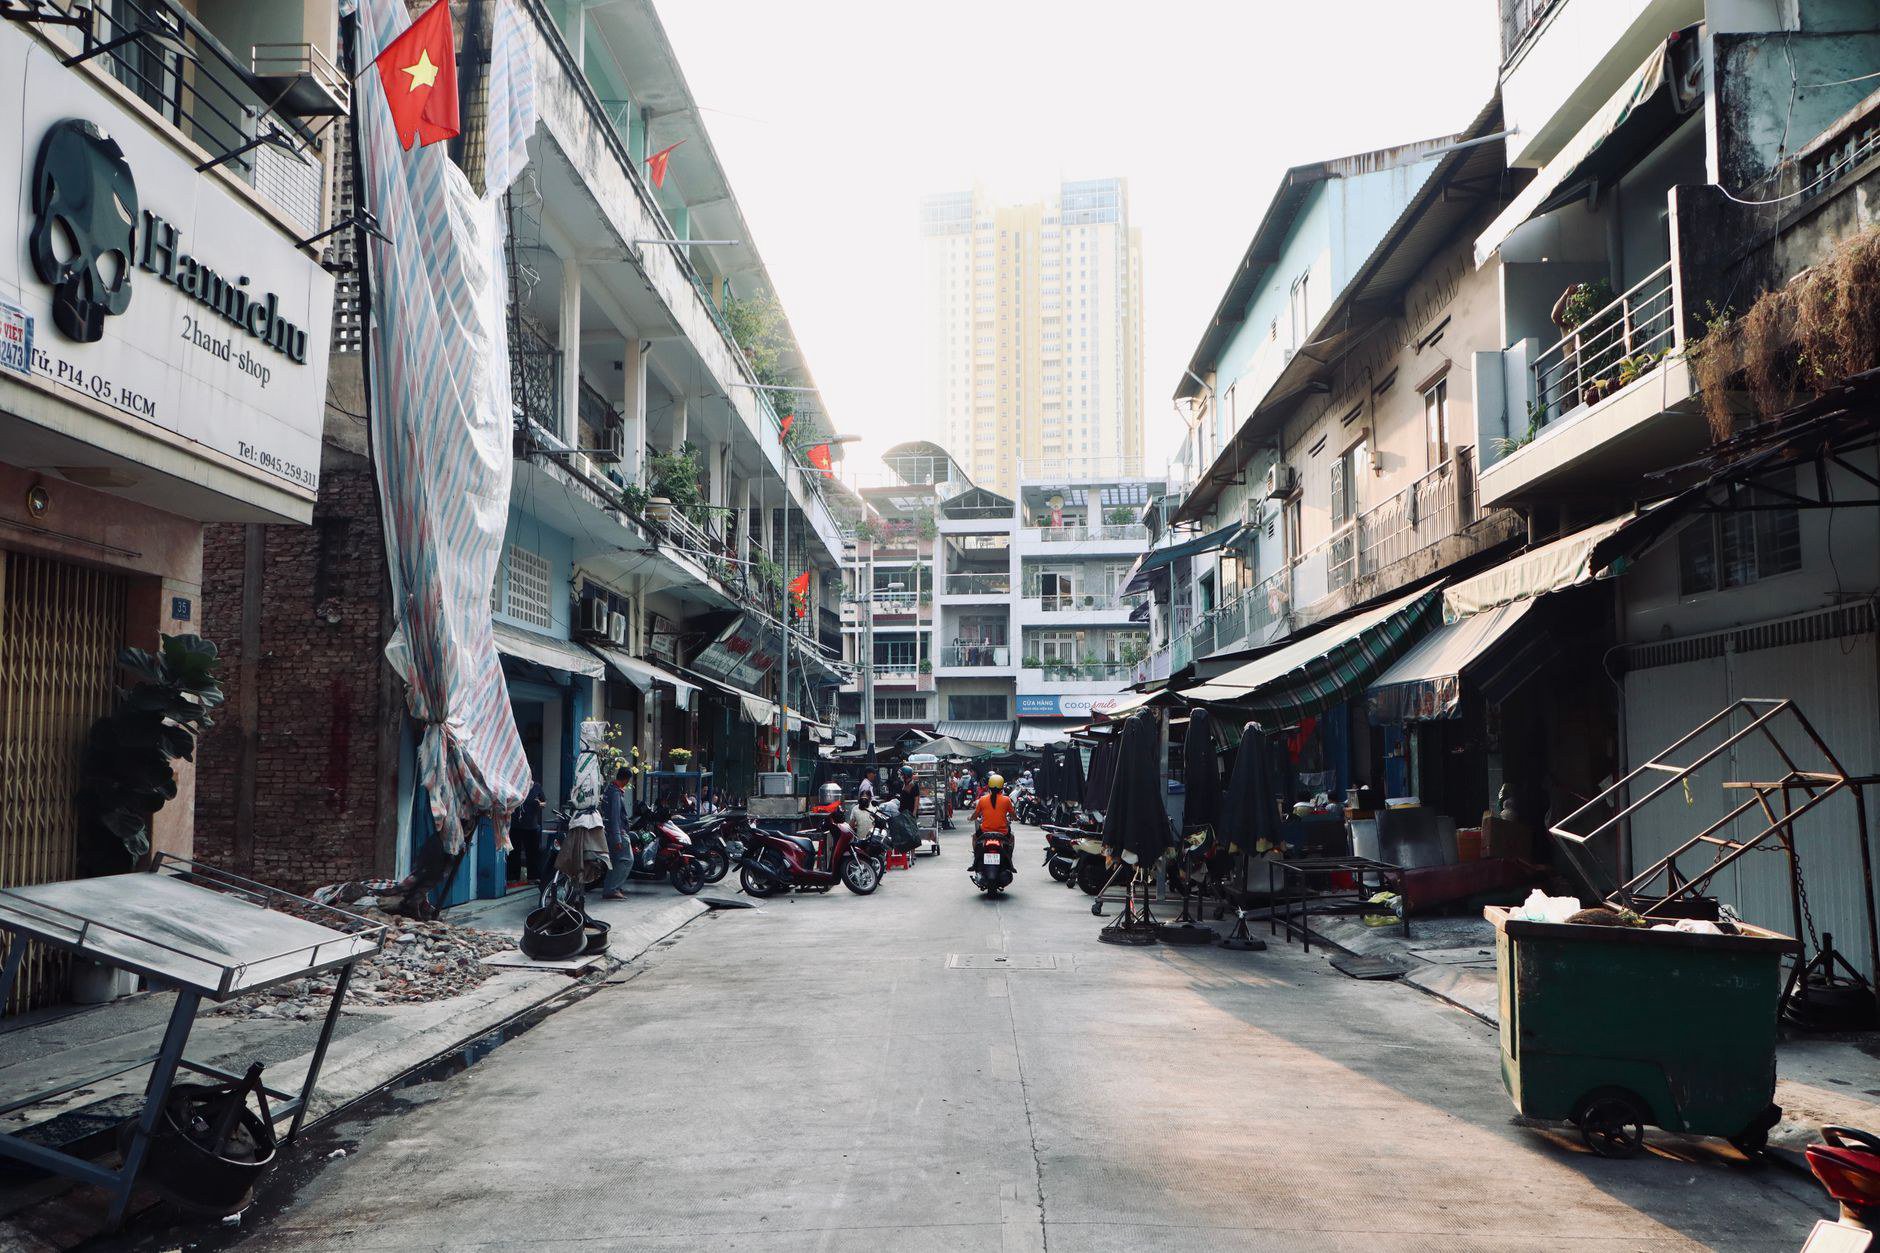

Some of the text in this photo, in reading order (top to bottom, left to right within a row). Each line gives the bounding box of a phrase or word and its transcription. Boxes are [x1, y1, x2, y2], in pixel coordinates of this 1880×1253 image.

[140, 210, 308, 365] Hamichu
[0, 341, 23, 366] 2473
[181, 315, 271, 388] 2hand-shop
[121, 388, 156, 417] HCM
[238, 441, 316, 487] Tel: 0945.259.311
